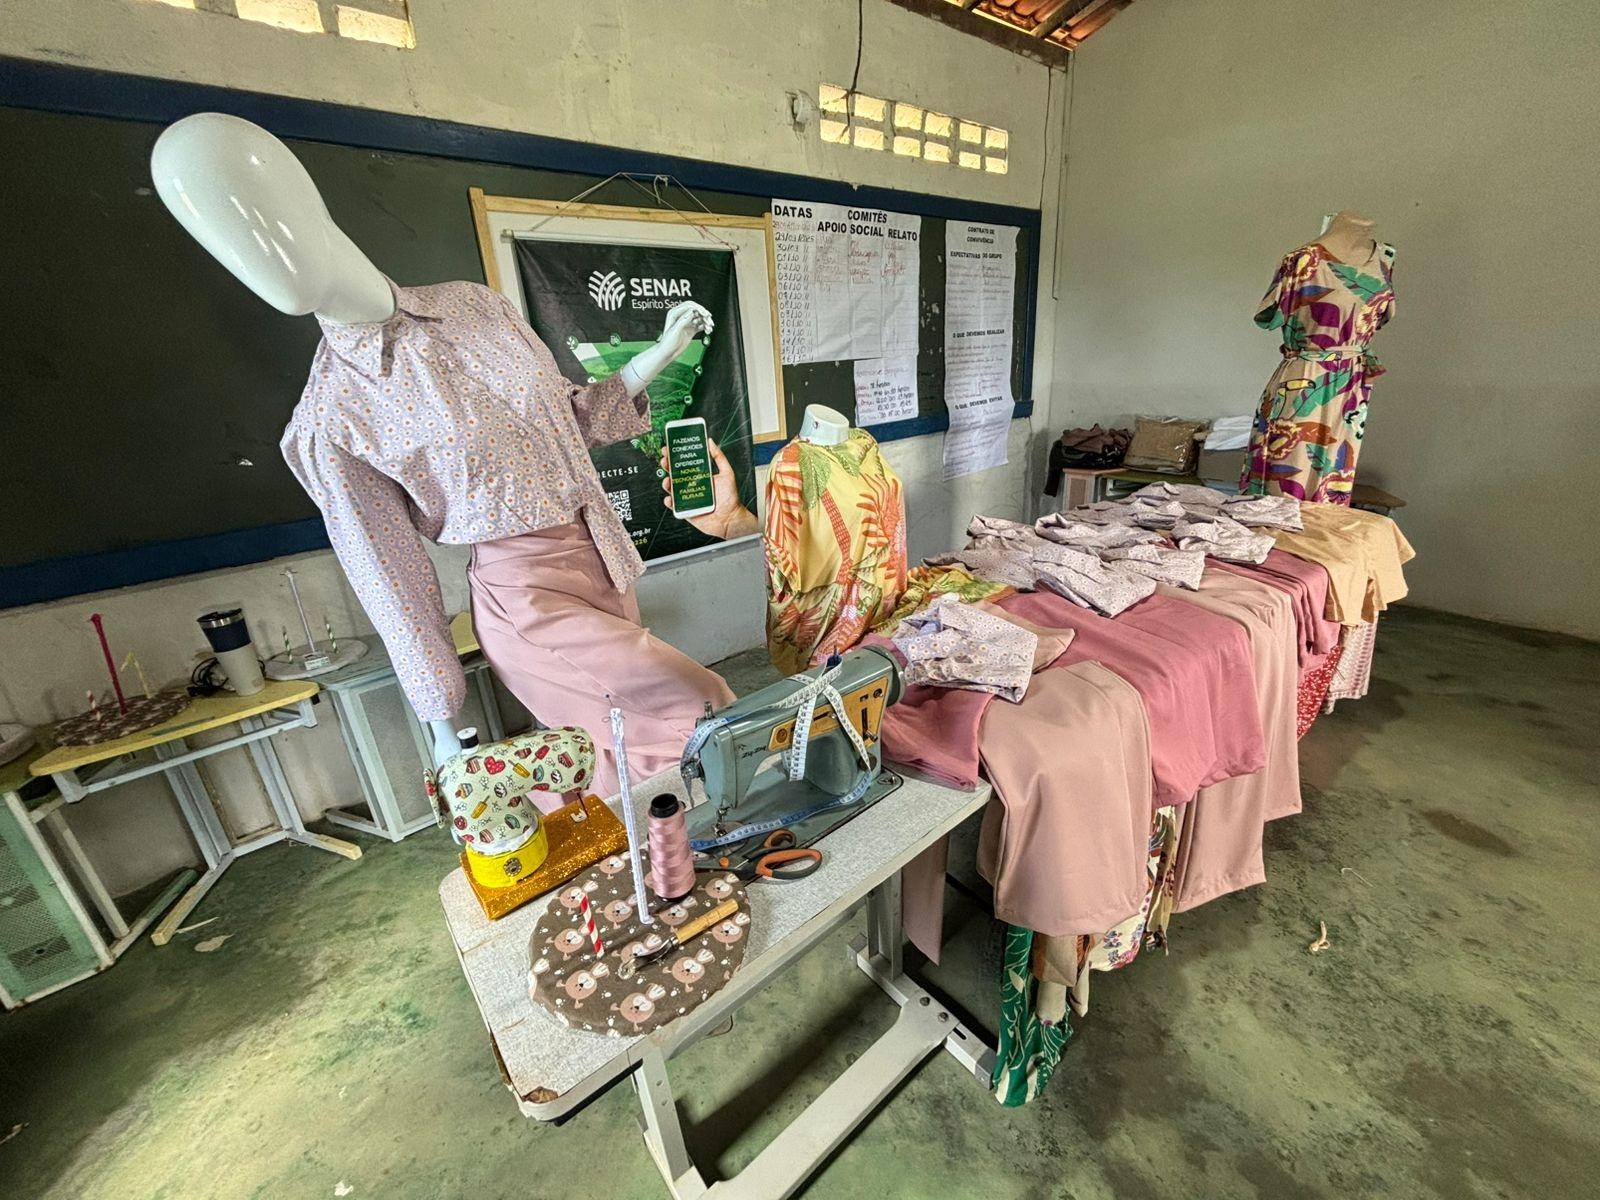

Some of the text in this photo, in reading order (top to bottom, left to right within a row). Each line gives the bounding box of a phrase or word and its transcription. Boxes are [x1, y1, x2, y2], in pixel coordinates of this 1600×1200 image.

[774, 205, 813, 218] DATAS
[817, 221, 847, 233] APOIO
[850, 225, 884, 237] SOCIAL
[888, 228, 918, 241] RELATO
[967, 226, 989, 235] CONTRATO
[630, 277, 692, 297] SENAR
[631, 298, 684, 311] Espírito San
[673, 436, 700, 445] FAZEMOS
[598, 465, 638, 479] ECTE-SE
[630, 527, 651, 538] .org.br
